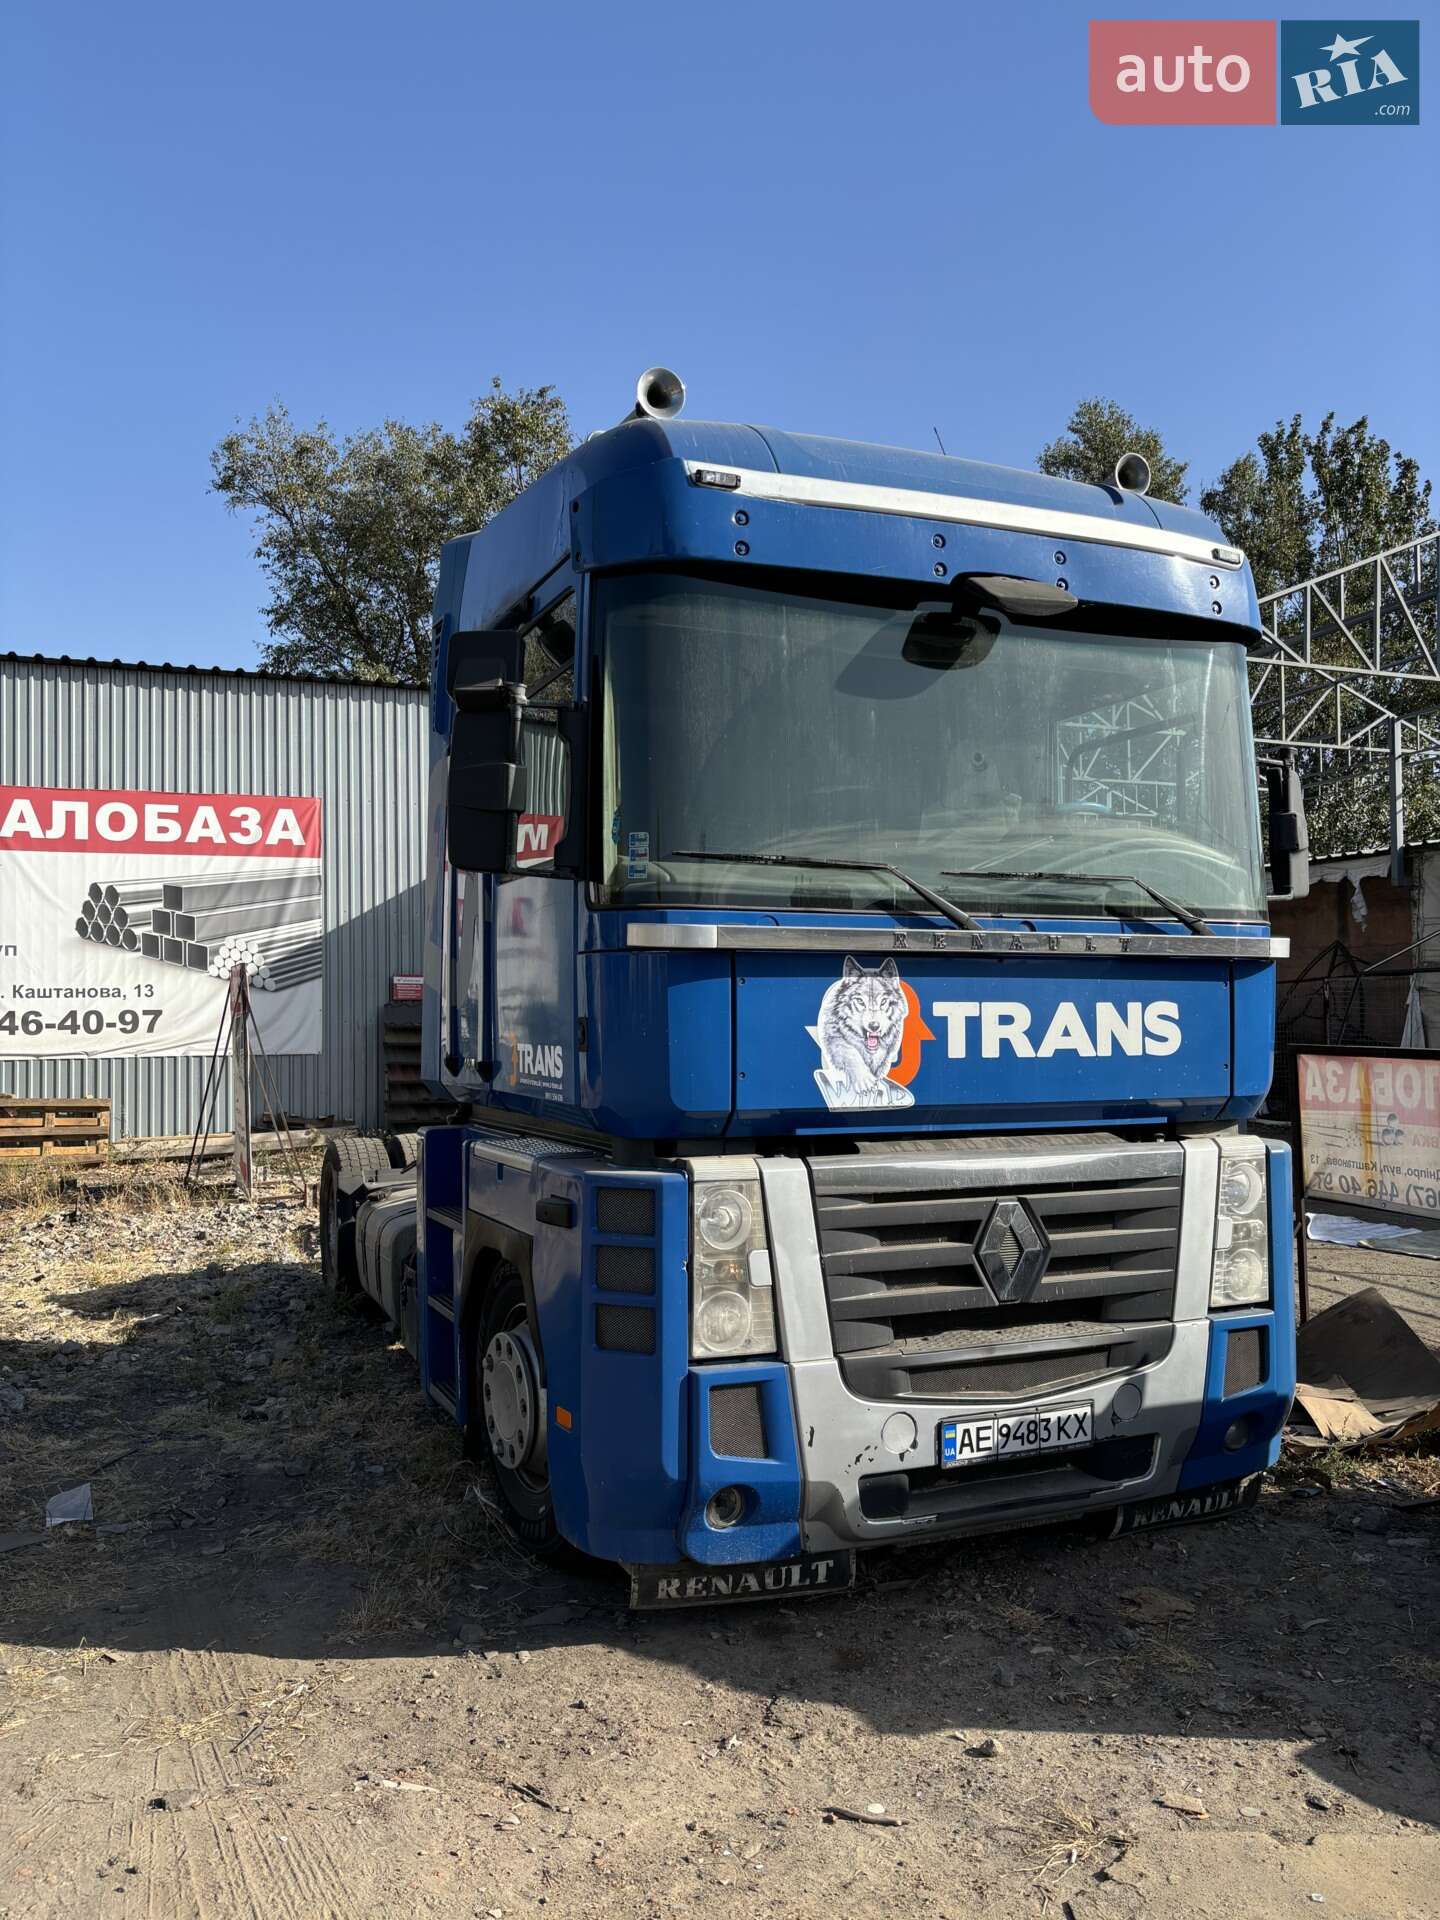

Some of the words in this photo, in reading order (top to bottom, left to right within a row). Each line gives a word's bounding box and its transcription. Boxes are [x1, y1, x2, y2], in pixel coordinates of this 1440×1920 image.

[0, 798, 306, 847] АЛОБАЗА
[892, 931, 1132, 953] RENAULT
[12, 984, 127, 999] Каштанова,
[133, 984, 155, 998] 13
[0, 1009, 163, 1036] 46-40-97
[932, 1000, 1182, 1058] TRANS
[517, 1042, 563, 1079] TRANS
[958, 1425, 993, 1455] AE
[1000, 1417, 1052, 1449] 9483
[1057, 1411, 1089, 1441] KX
[944, 1448, 956, 1457] UA
[657, 1559, 835, 1600] RENAULT
